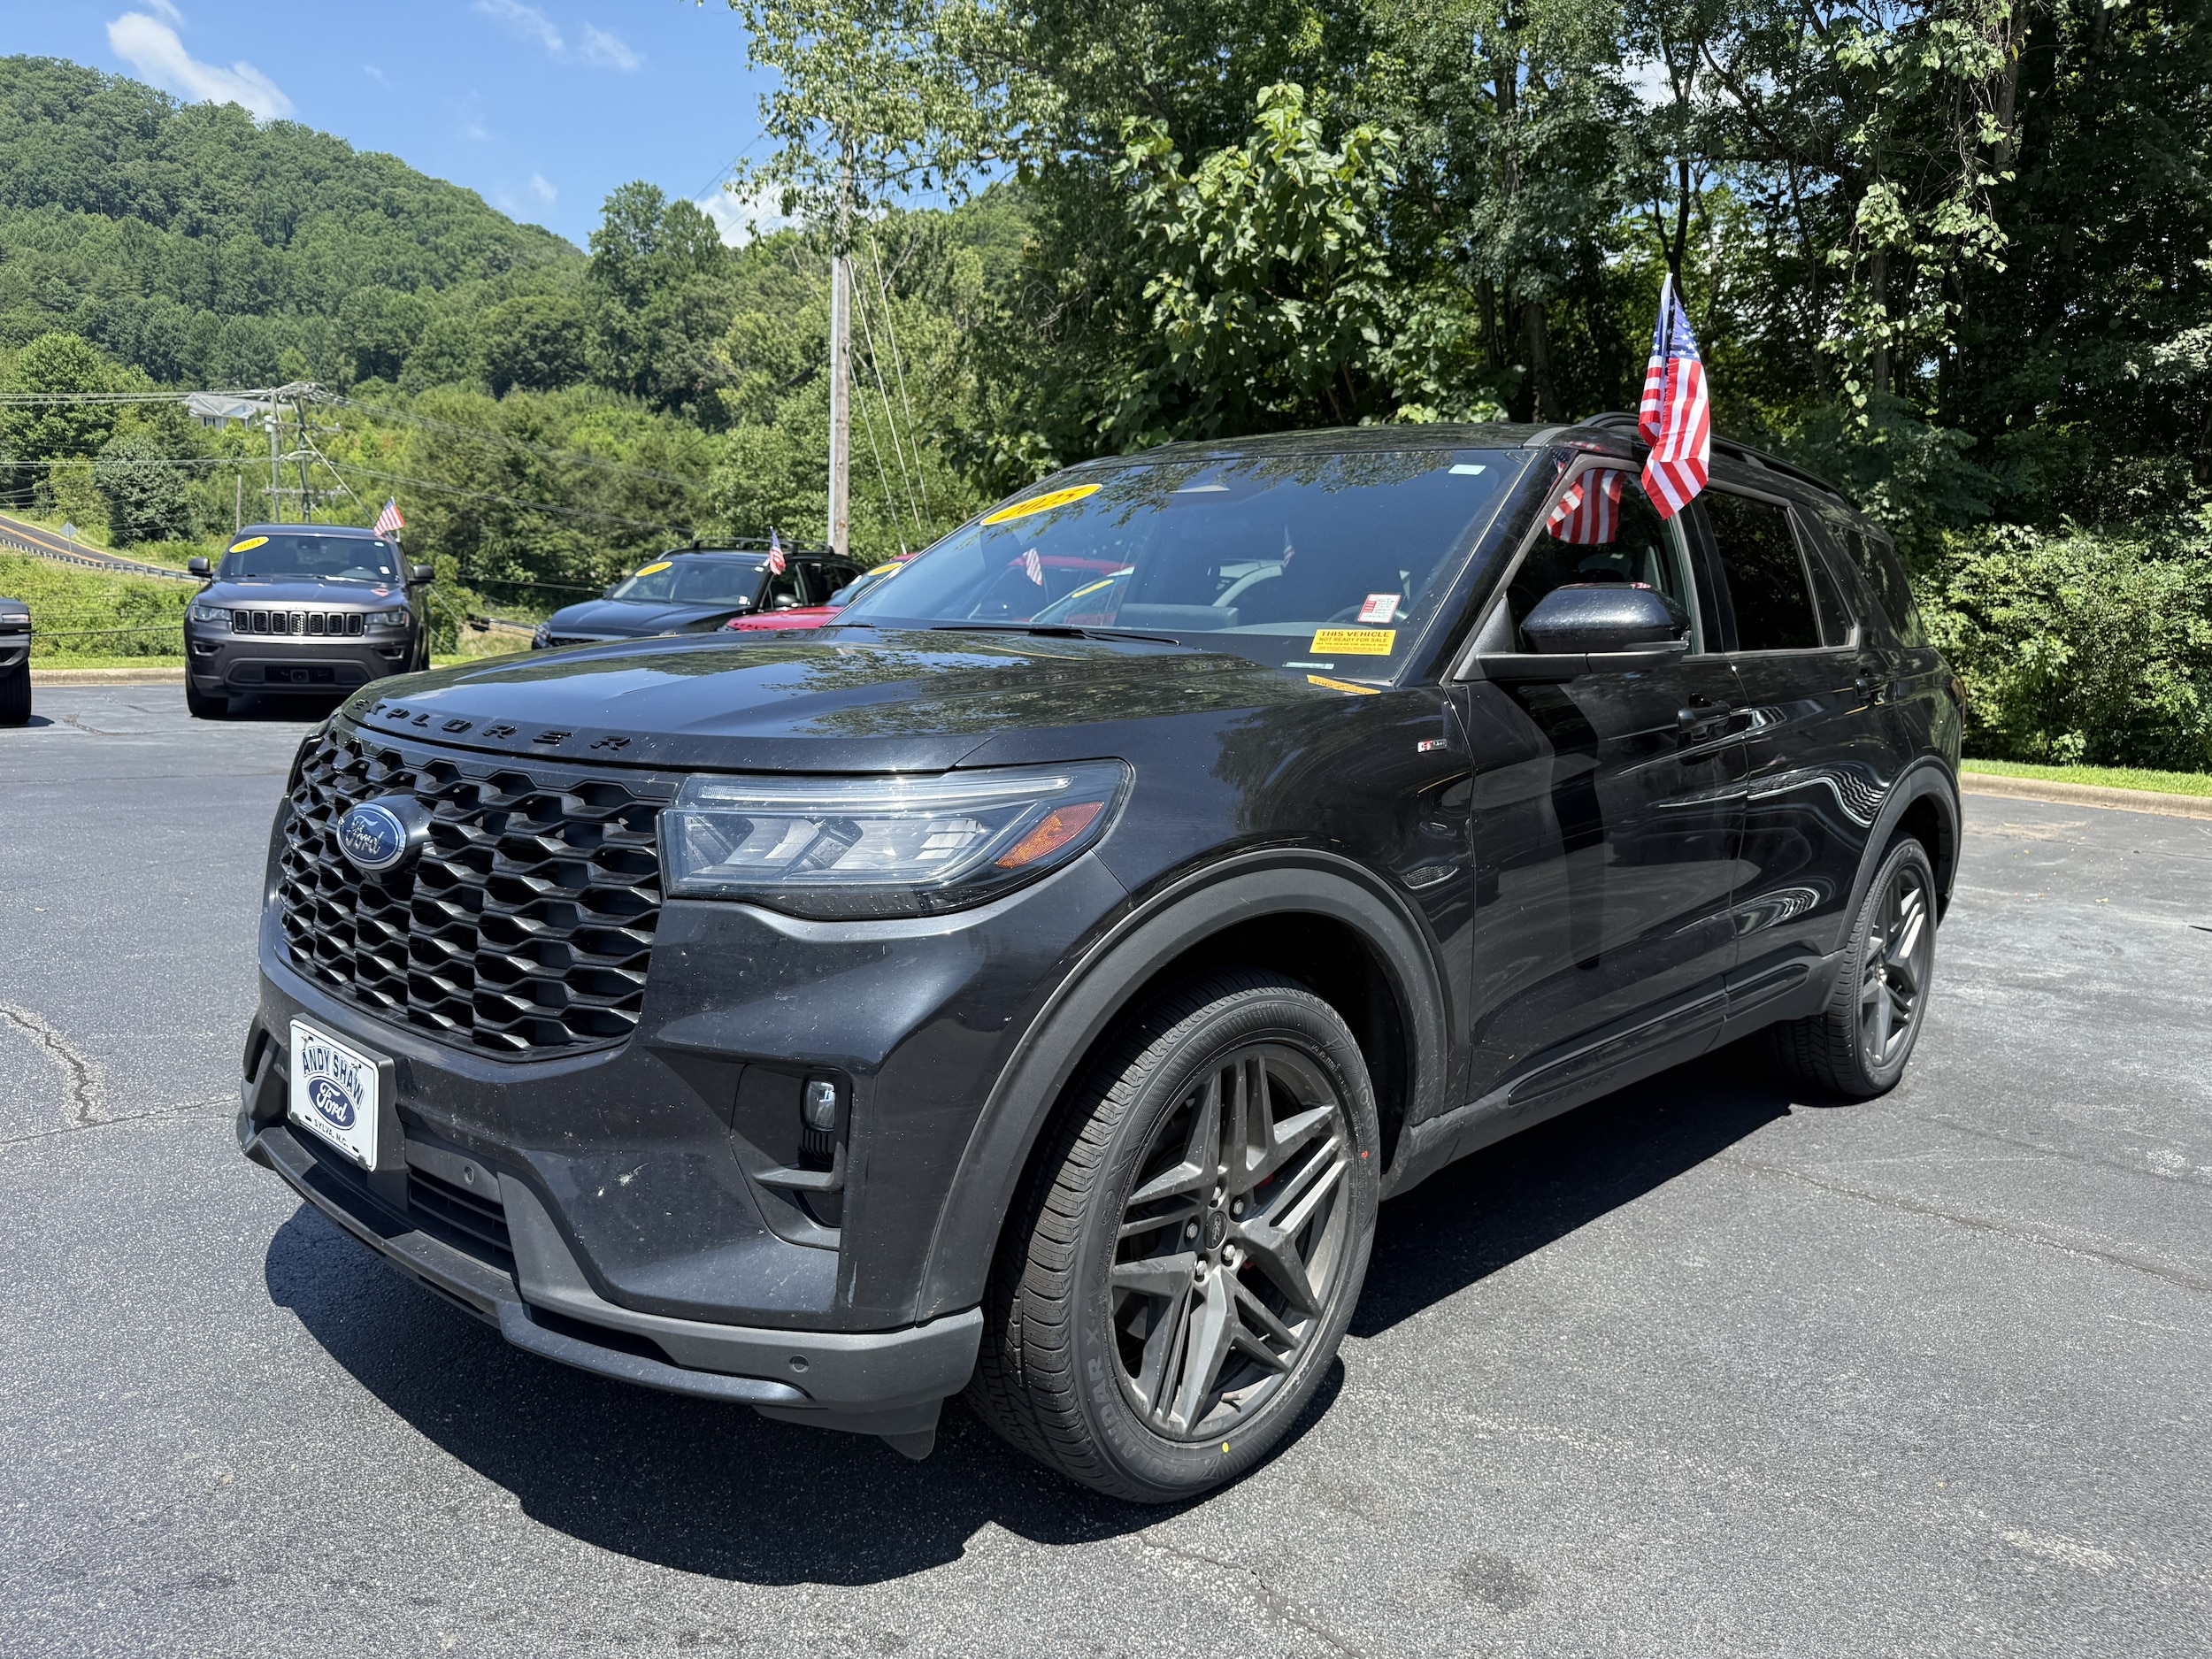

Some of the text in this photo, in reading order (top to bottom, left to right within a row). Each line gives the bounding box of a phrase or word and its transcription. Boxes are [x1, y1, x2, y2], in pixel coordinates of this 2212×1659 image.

[353, 697, 632, 751] EXPLORER
[345, 814, 385, 856] Ford
[301, 1045, 365, 1110] ANDY SHAW
[316, 1081, 349, 1123] Ford
[313, 1118, 350, 1148] SYLVA, N.C.
[1087, 1355, 1193, 1486] GEOLANDAR
